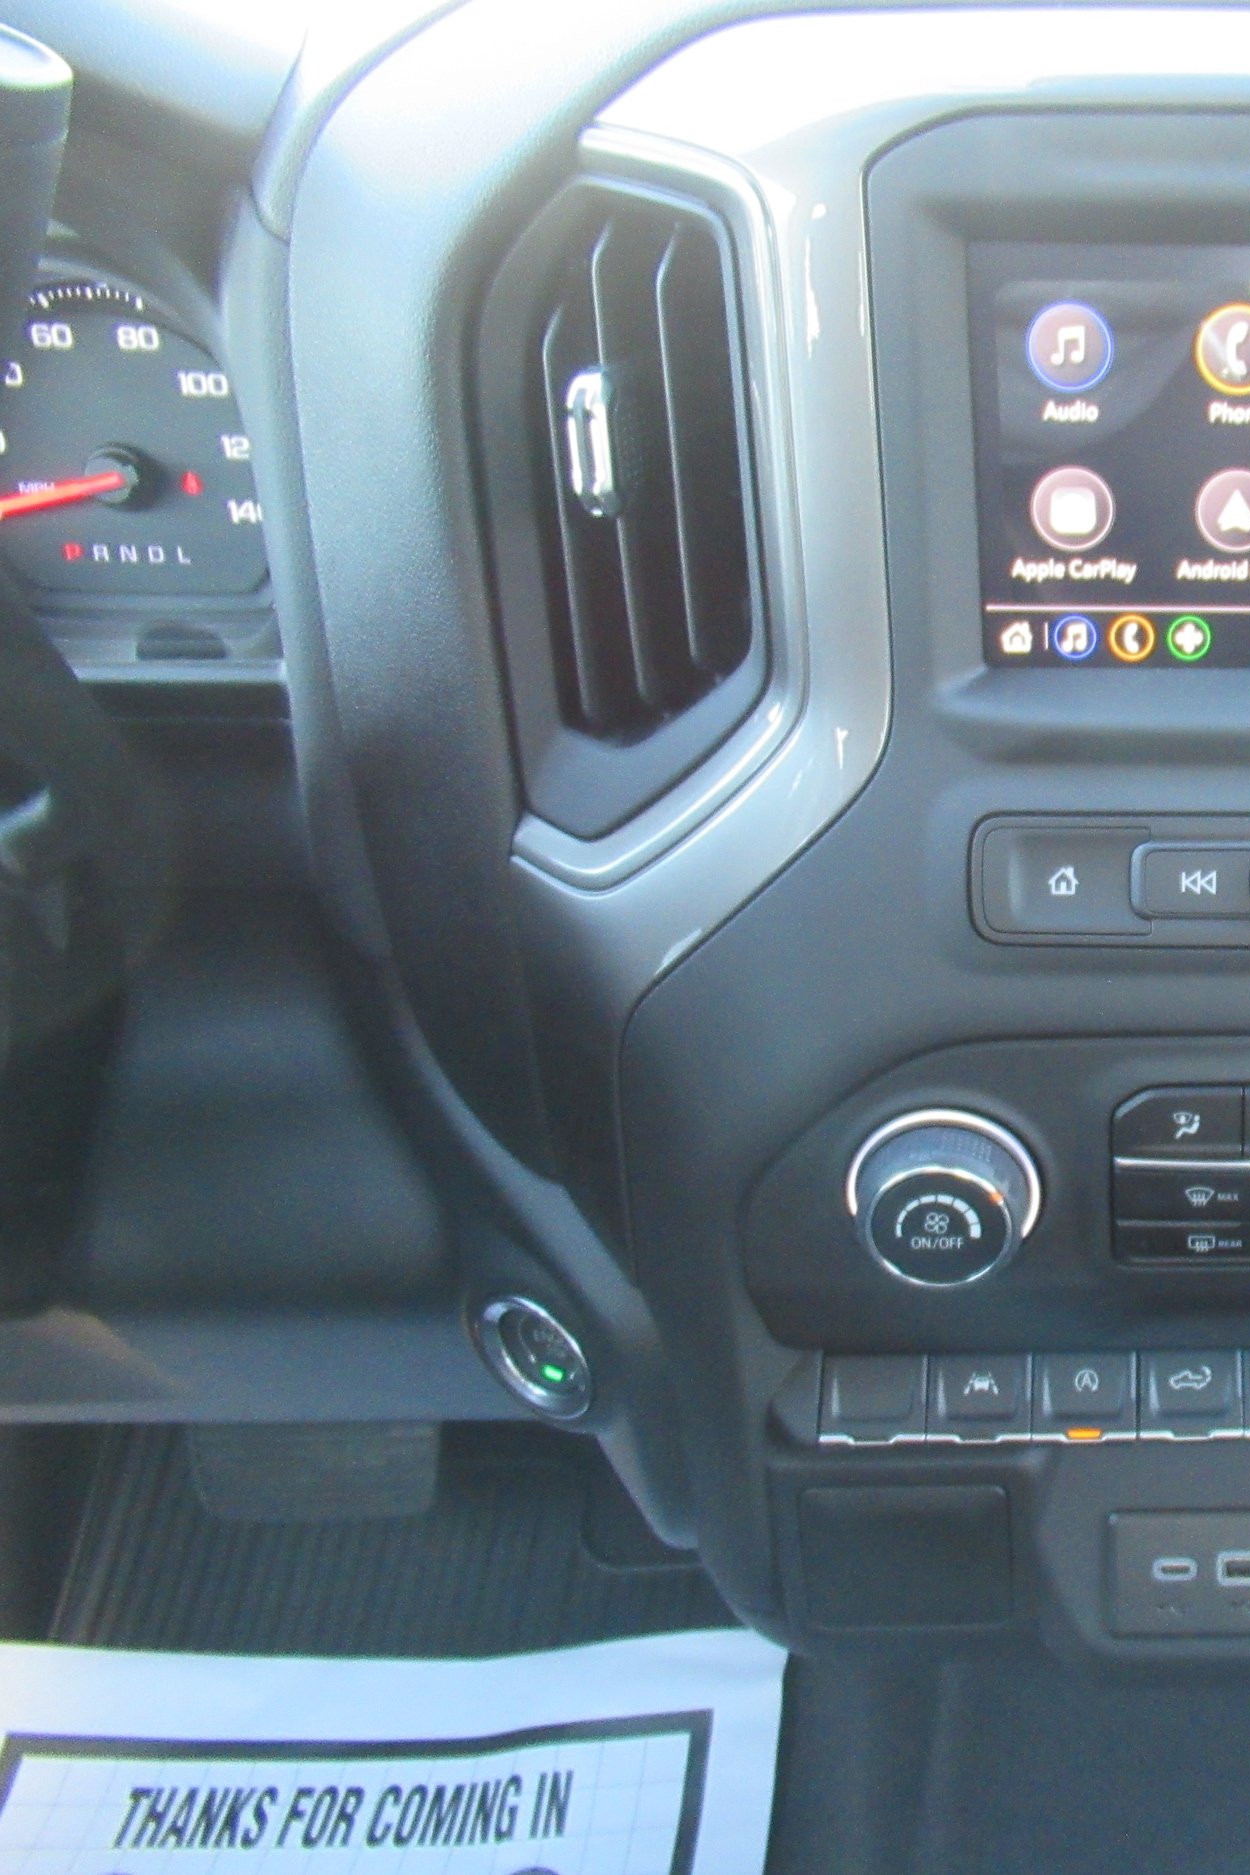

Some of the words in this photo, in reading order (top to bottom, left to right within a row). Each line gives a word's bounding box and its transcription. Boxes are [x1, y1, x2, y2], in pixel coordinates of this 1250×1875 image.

[31, 323, 73, 349] 60
[117, 325, 159, 351] 80
[177, 372, 229, 397] 100
[1043, 401, 1099, 423] Audio
[226, 499, 264, 525] 14
[64, 542, 82, 561] P
[92, 543, 110, 562] R
[119, 544, 138, 563] N
[147, 545, 166, 564] D
[177, 545, 192, 564] L
[1011, 559, 1065, 582] Apple
[1068, 559, 1137, 584] CarPlay
[1177, 560, 1249, 581] Android
[911, 1236, 965, 1250] ON/OFF
[112, 1784, 278, 1849] THANKS
[274, 1784, 364, 1848] FOR
[366, 1773, 523, 1847] COMING
[528, 1769, 575, 1838] IN
